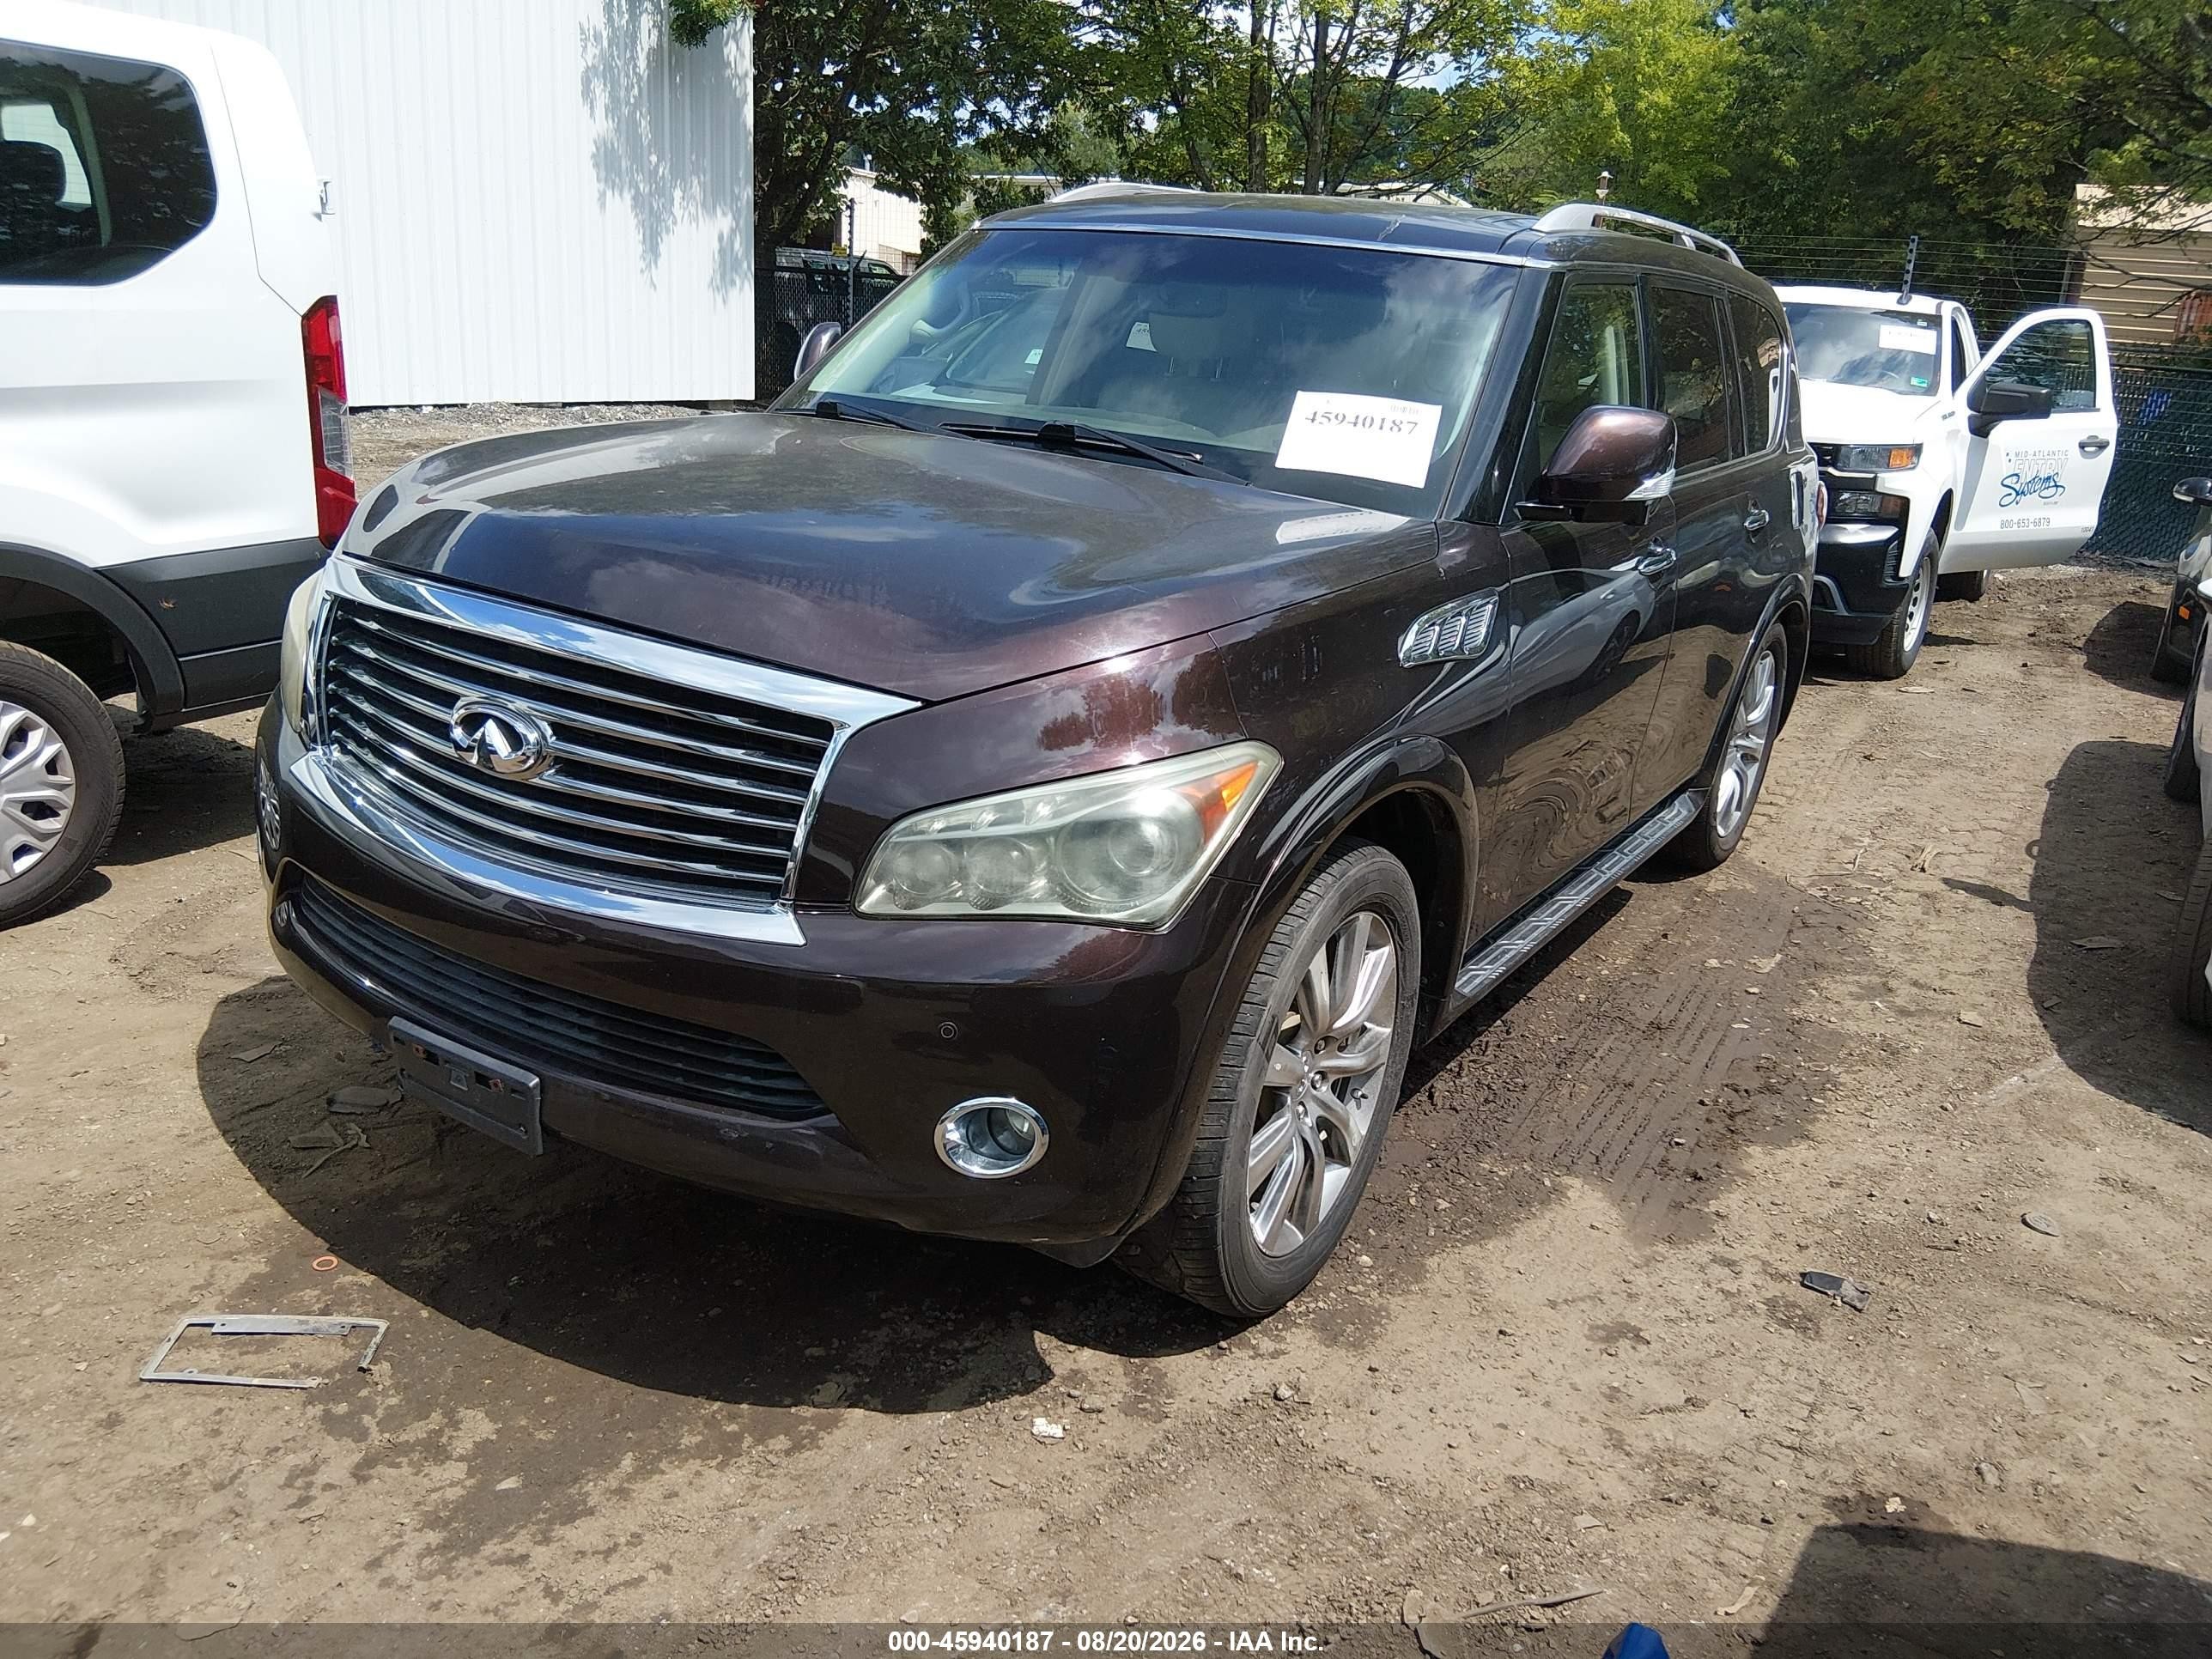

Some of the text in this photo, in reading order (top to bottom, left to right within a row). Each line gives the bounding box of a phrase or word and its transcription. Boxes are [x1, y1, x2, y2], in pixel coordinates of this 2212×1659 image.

[1304, 410, 1419, 434] 45940187
[2013, 458, 2069, 483] ENTRY
[1998, 472, 2066, 507] Systems
[2000, 517, 2051, 529] 800-653-6879
